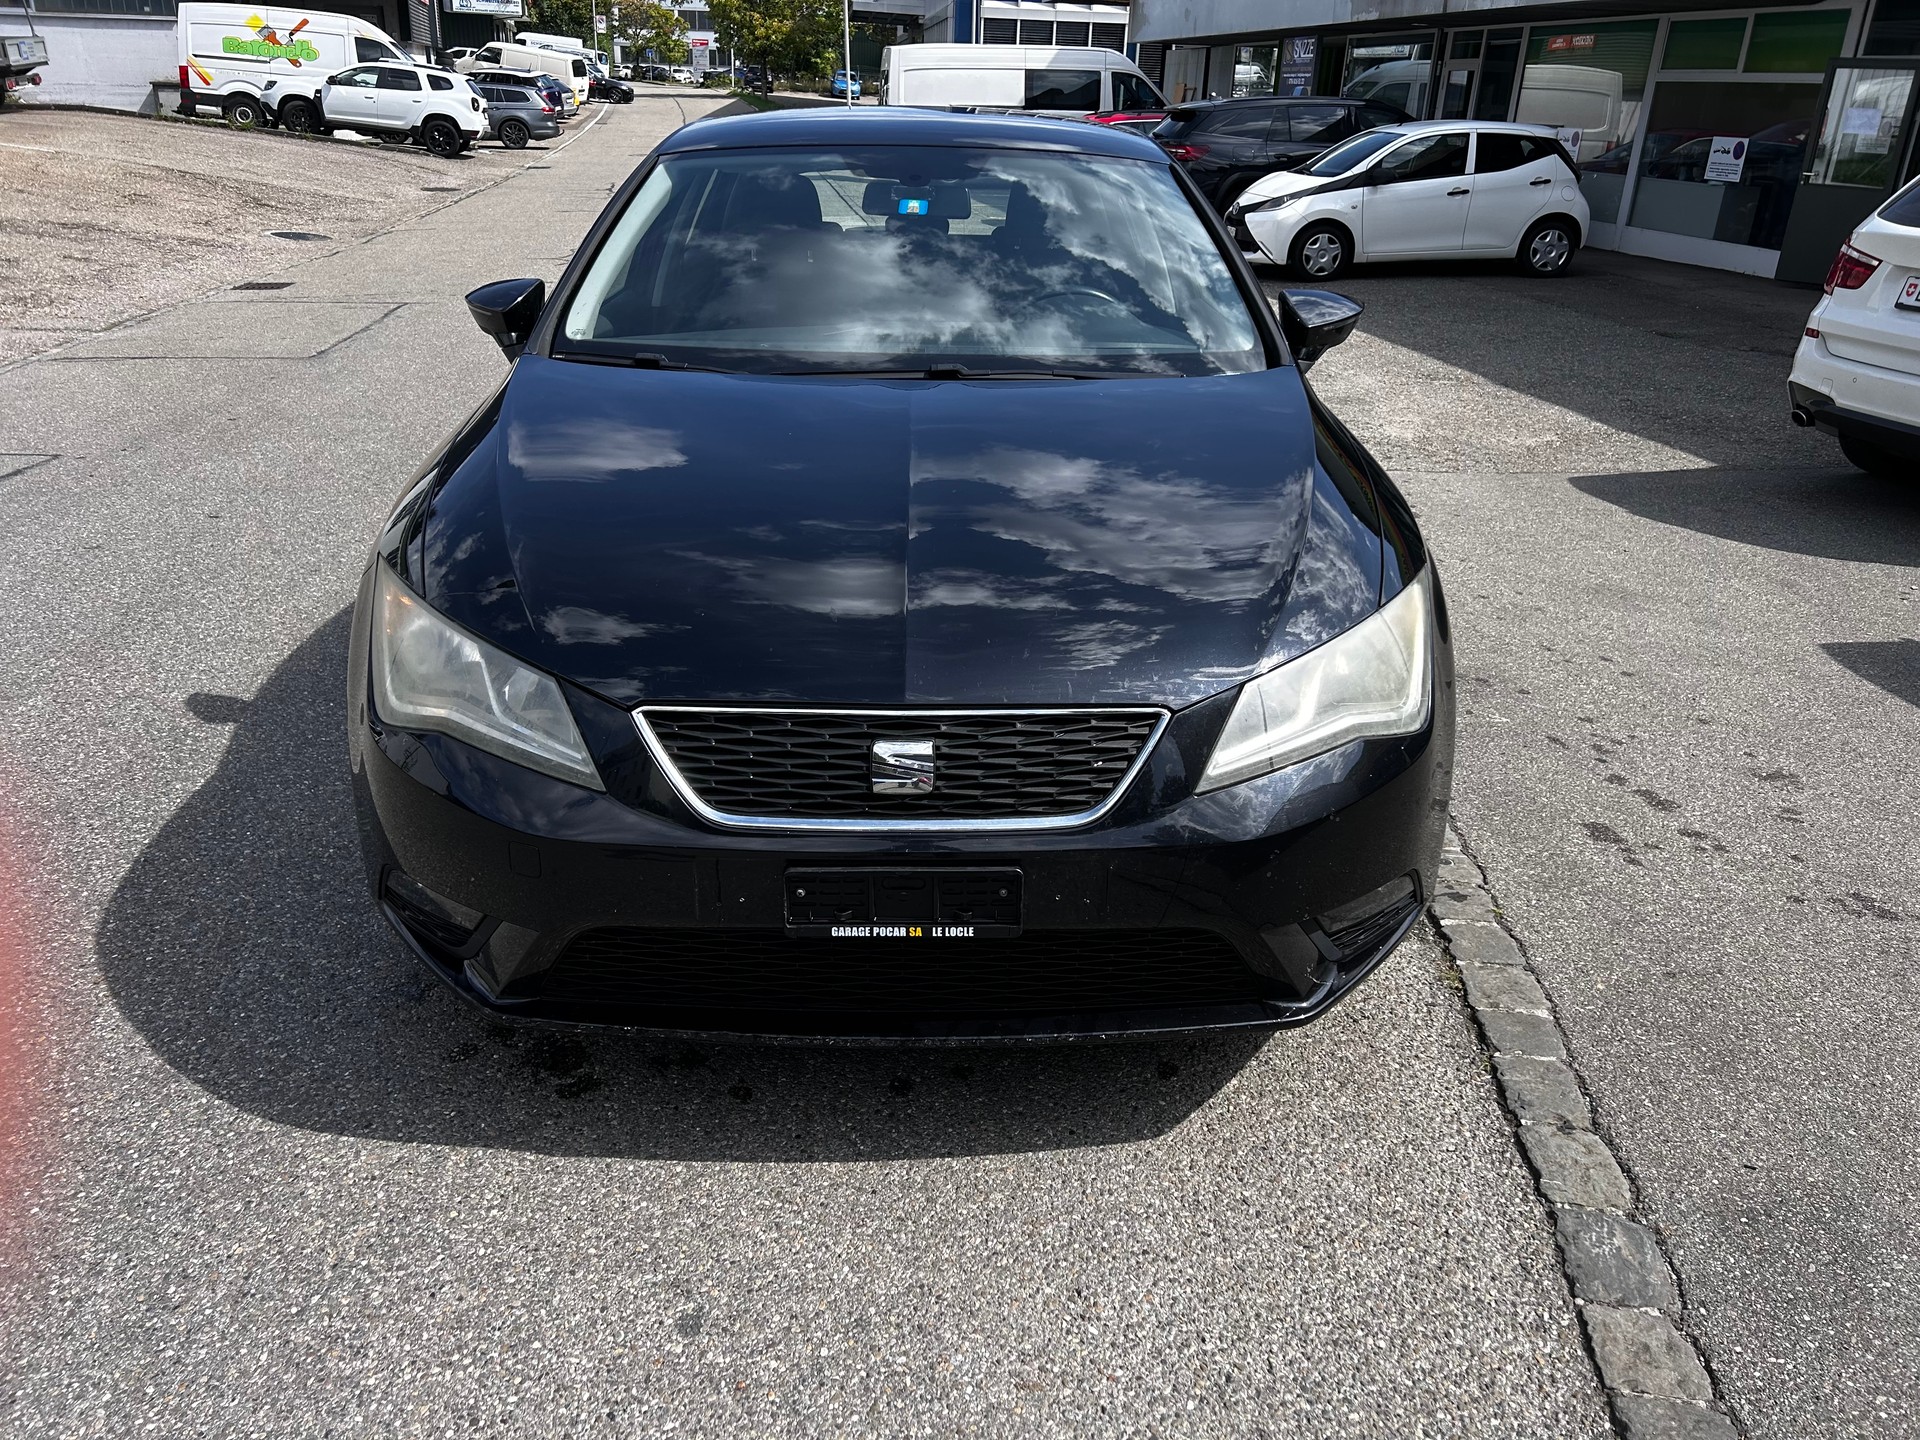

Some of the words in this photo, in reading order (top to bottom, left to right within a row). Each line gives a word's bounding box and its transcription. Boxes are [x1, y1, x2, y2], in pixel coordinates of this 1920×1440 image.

[831, 926, 871, 937] GARAGE
[873, 926, 907, 937] POCAR
[909, 926, 923, 937] SA
[932, 926, 943, 937] LE
[945, 926, 975, 937] LOCLE
